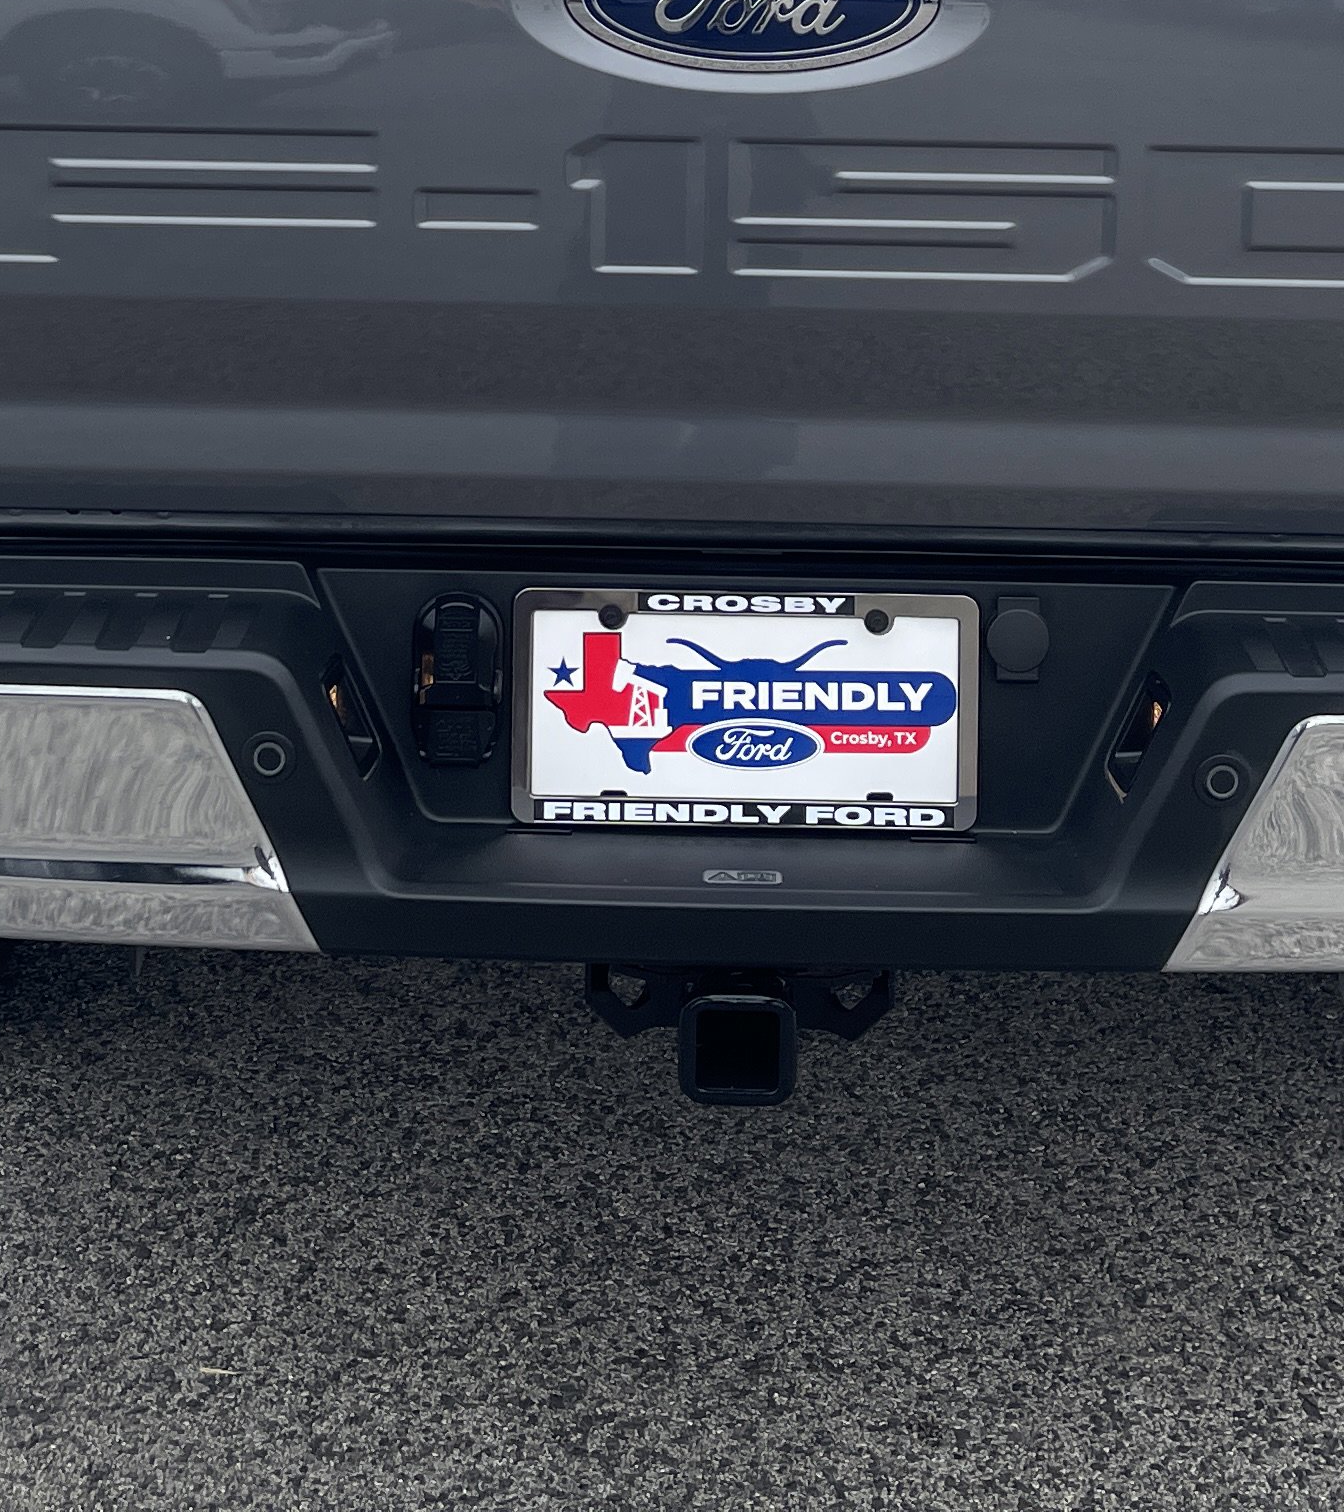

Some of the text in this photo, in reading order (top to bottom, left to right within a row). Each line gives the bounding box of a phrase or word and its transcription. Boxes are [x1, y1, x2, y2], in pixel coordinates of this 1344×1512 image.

[647, 593, 847, 614] CROSBY
[691, 680, 933, 712] FRIENDLY
[715, 727, 793, 763] Ford
[830, 730, 916, 748] Crosby, TX
[543, 801, 946, 827] FRIENDLY FORD
